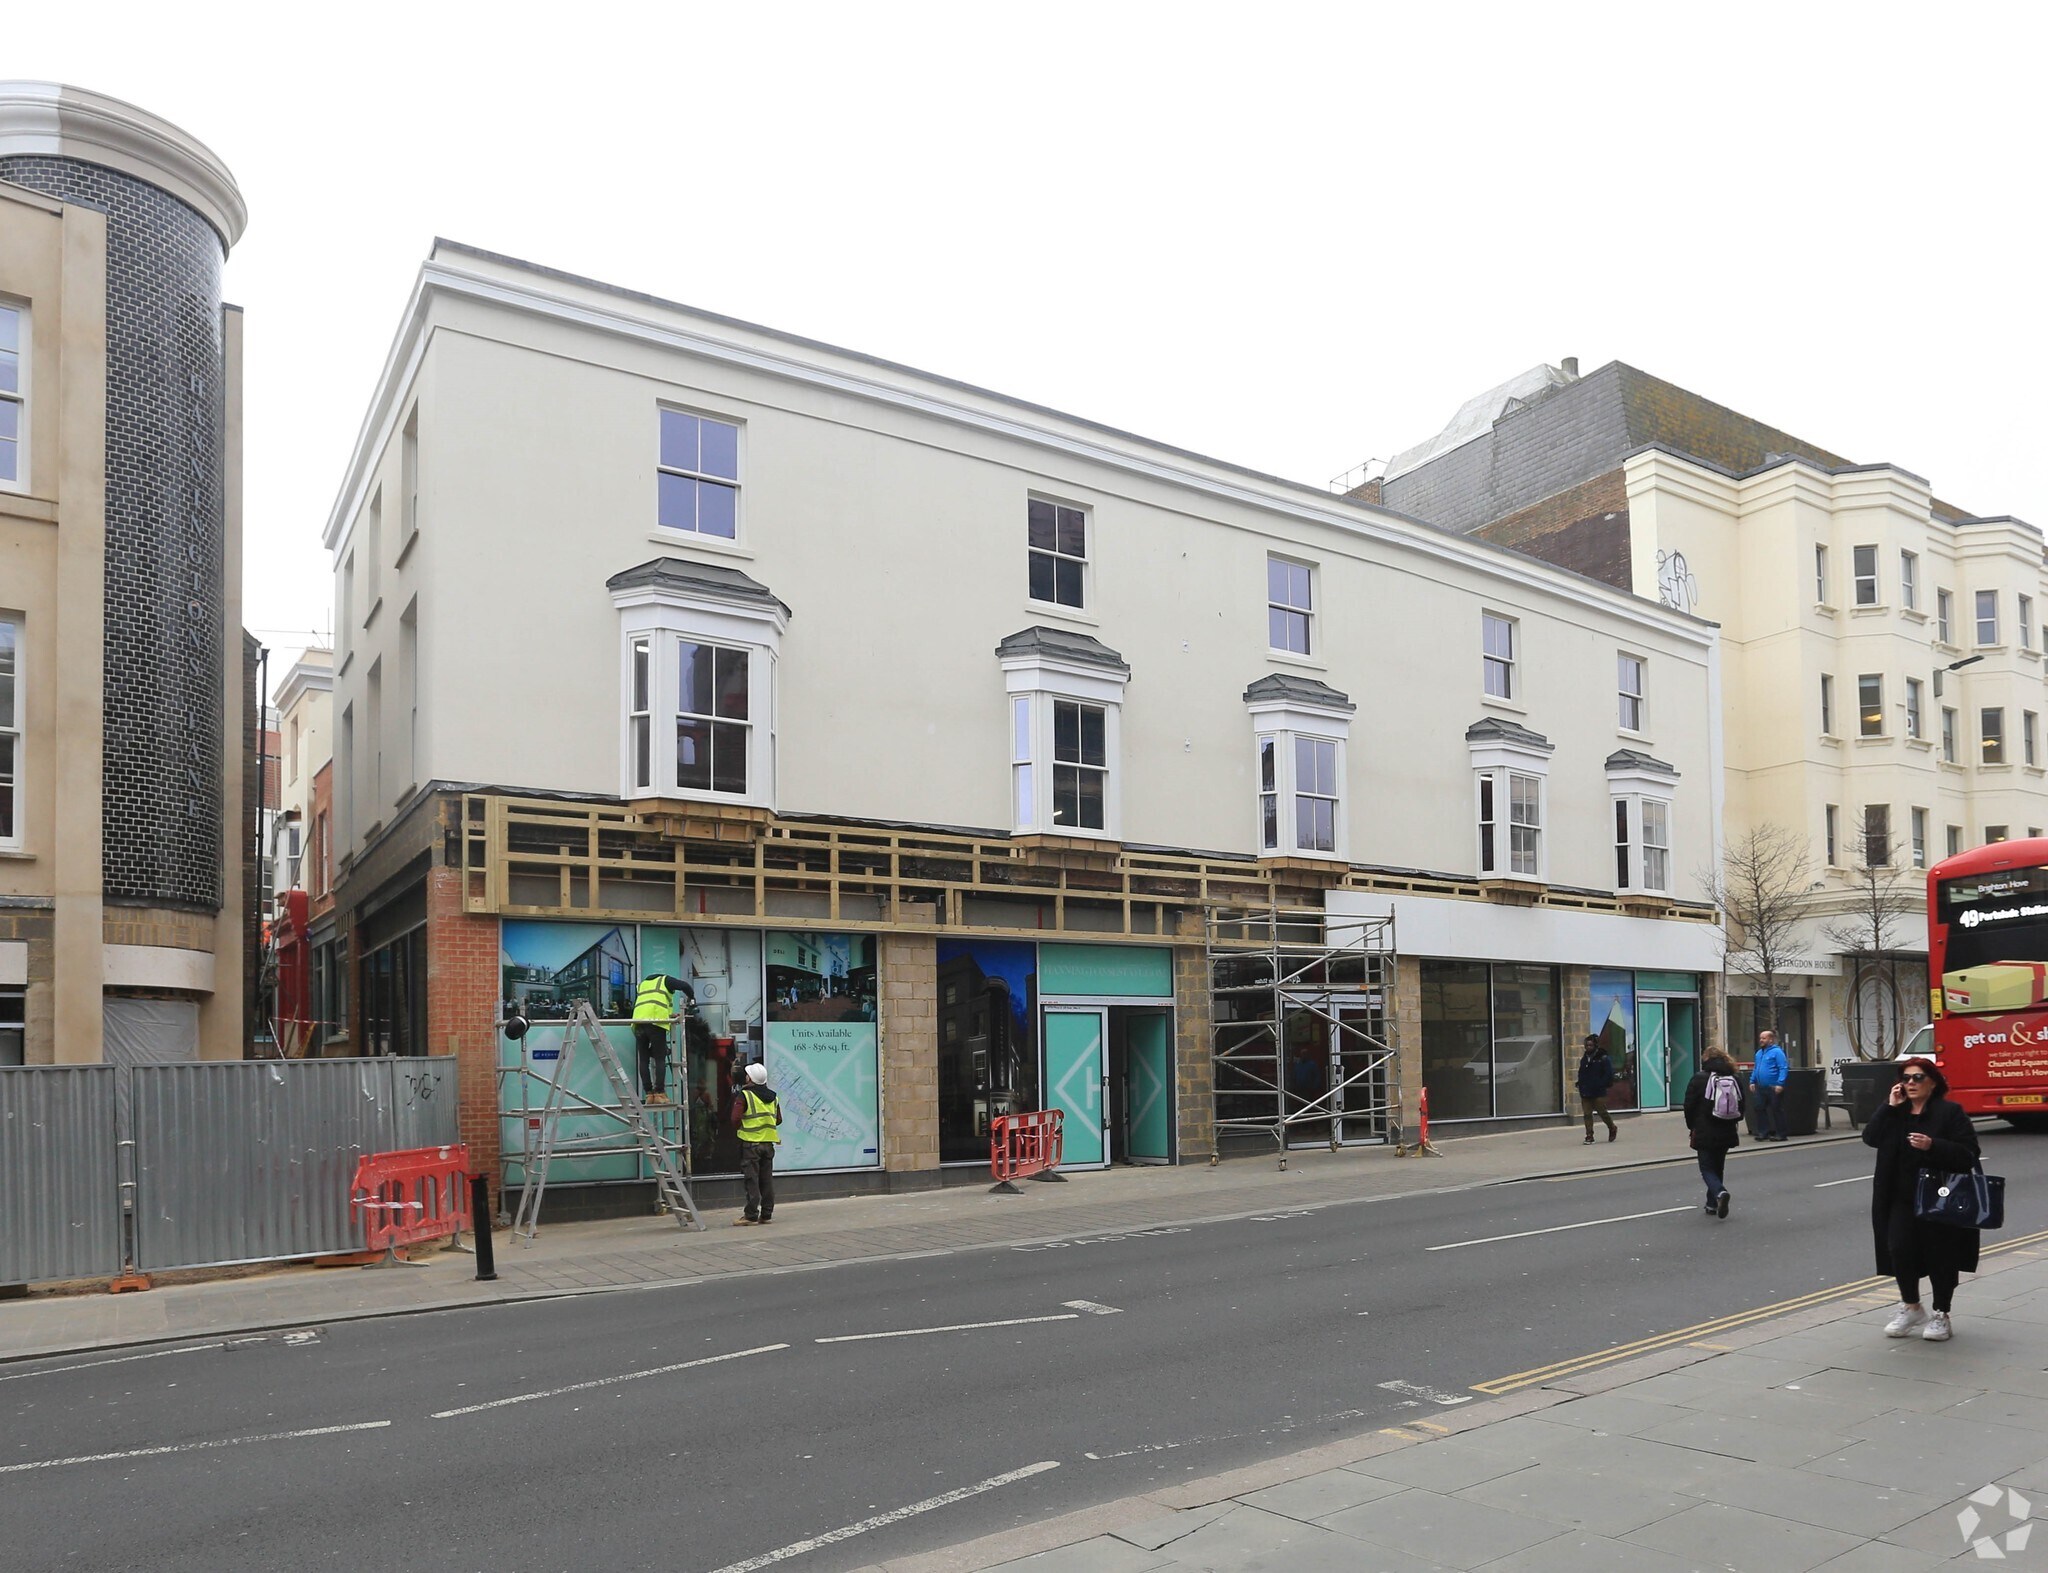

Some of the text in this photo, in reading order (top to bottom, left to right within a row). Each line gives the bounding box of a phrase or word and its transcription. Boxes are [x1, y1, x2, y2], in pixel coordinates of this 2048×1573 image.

[187, 710, 201, 818] LANE
[1959, 909, 1980, 928] 49
[1814, 960, 1836, 969] HOUSE
[792, 1029, 852, 1038] Units Available
[1964, 1032, 1985, 1048] get
[1987, 1033, 2007, 1043] on
[2010, 1021, 2038, 1046] &
[1988, 1059, 2021, 1068] Churchill
[1831, 1067, 1842, 1075] YO
